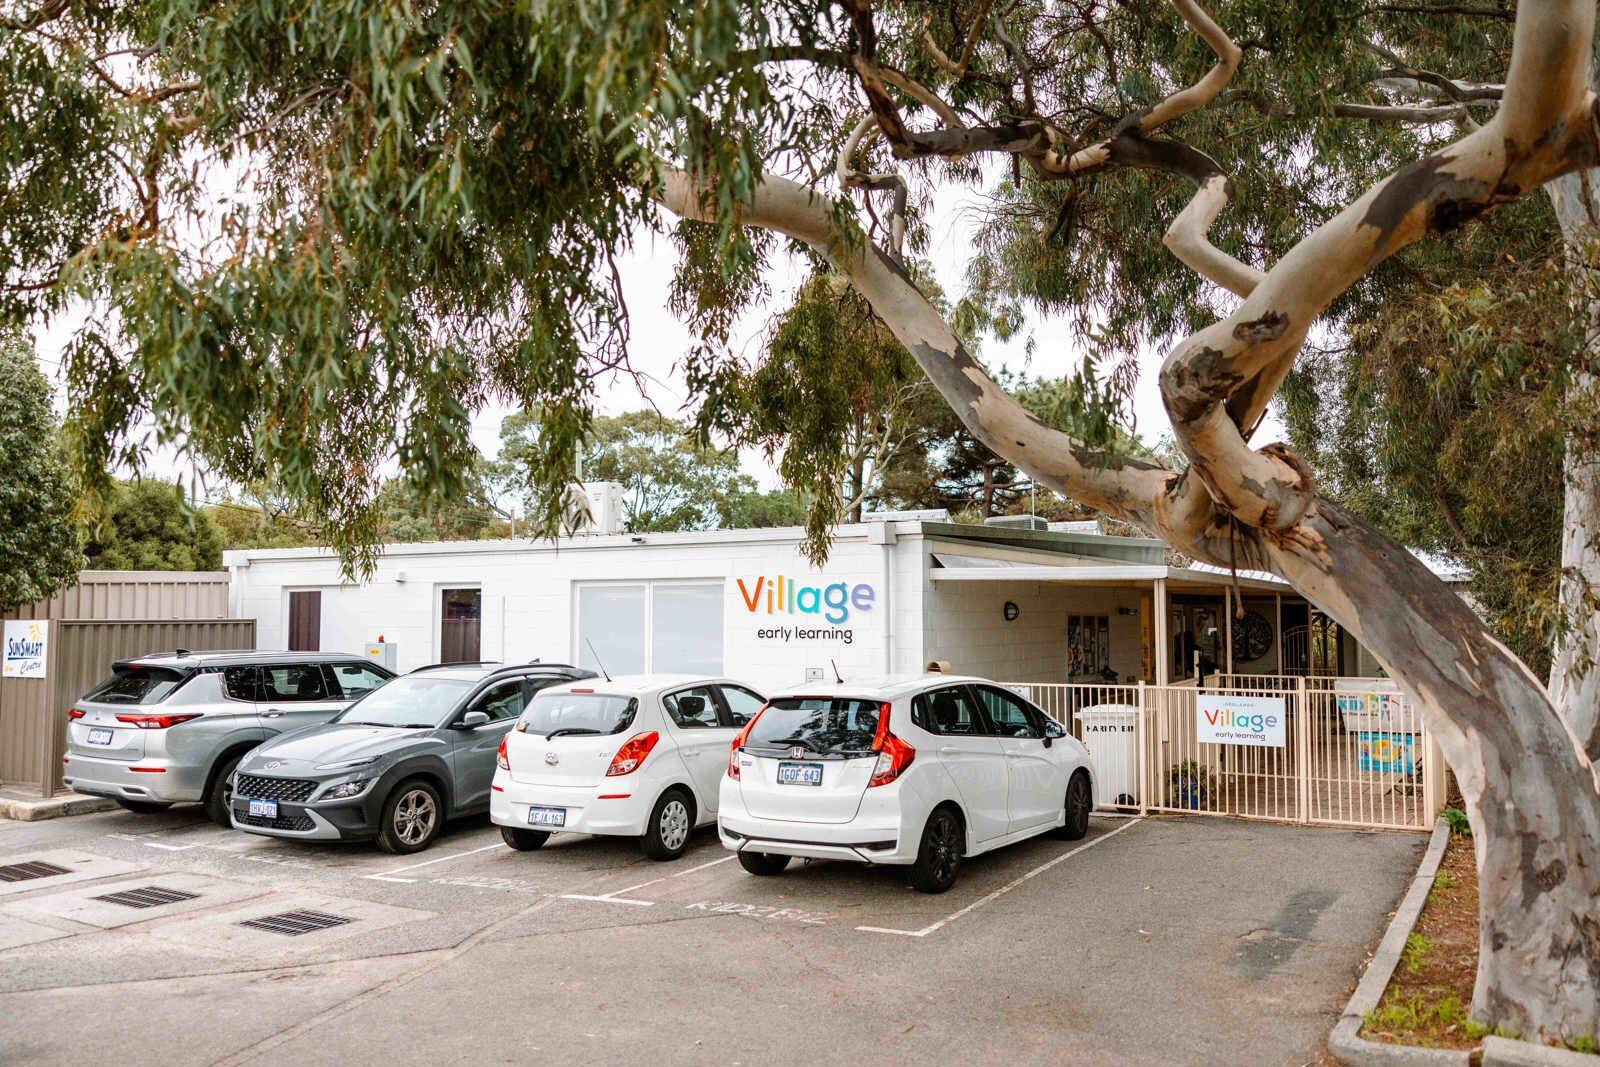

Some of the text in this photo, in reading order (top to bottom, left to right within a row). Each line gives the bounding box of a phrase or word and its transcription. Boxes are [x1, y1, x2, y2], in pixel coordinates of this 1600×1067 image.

[737, 575, 876, 624] Village
[757, 626, 853, 644] early learning
[1204, 708, 1278, 733] Village
[1215, 731, 1266, 741] early learning
